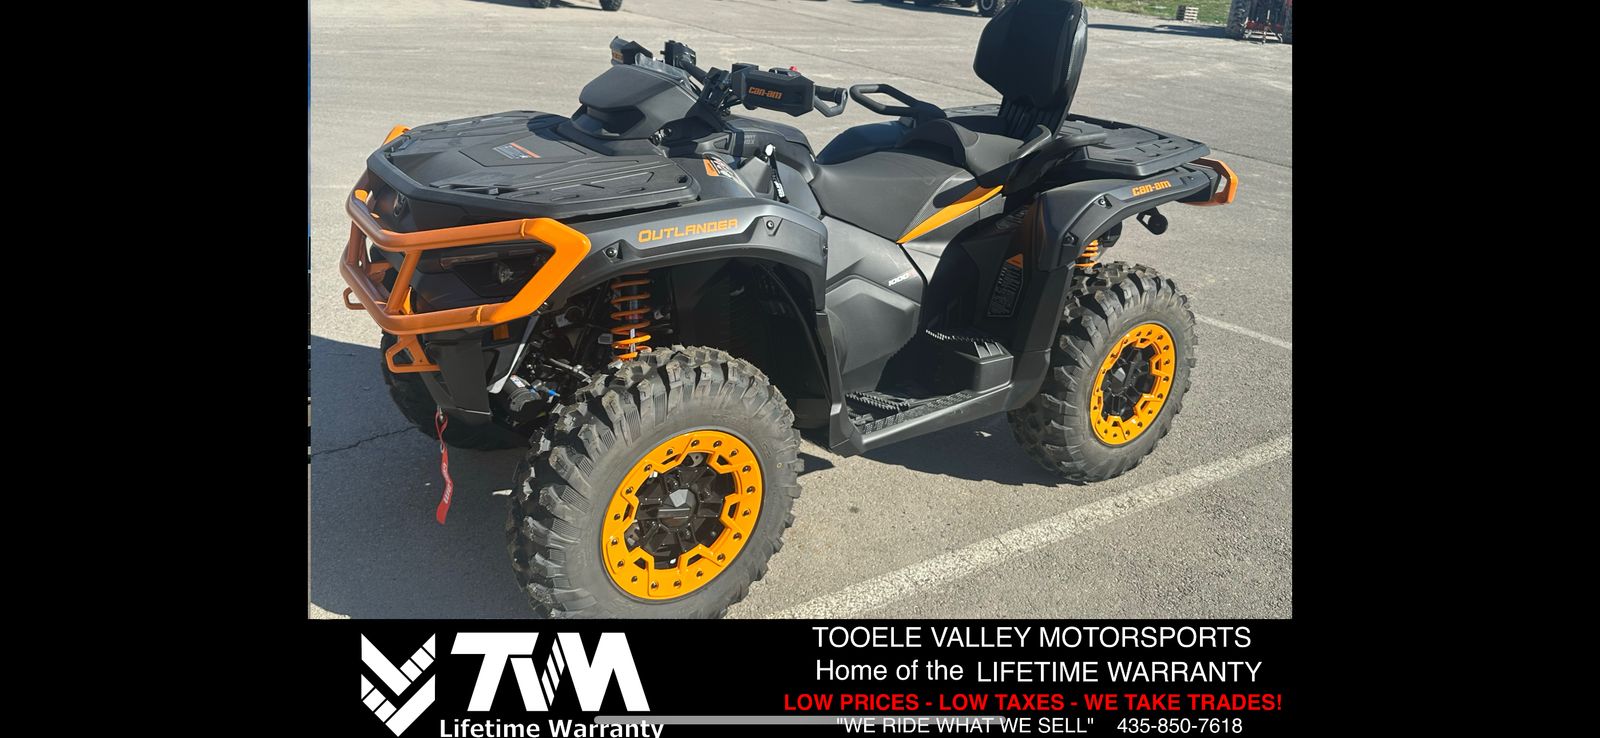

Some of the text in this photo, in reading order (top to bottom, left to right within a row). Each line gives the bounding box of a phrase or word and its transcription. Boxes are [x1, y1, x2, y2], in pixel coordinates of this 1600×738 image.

[748, 86, 783, 100] can-am
[1132, 180, 1172, 197] can-am
[638, 218, 738, 243] OUTLANDER
